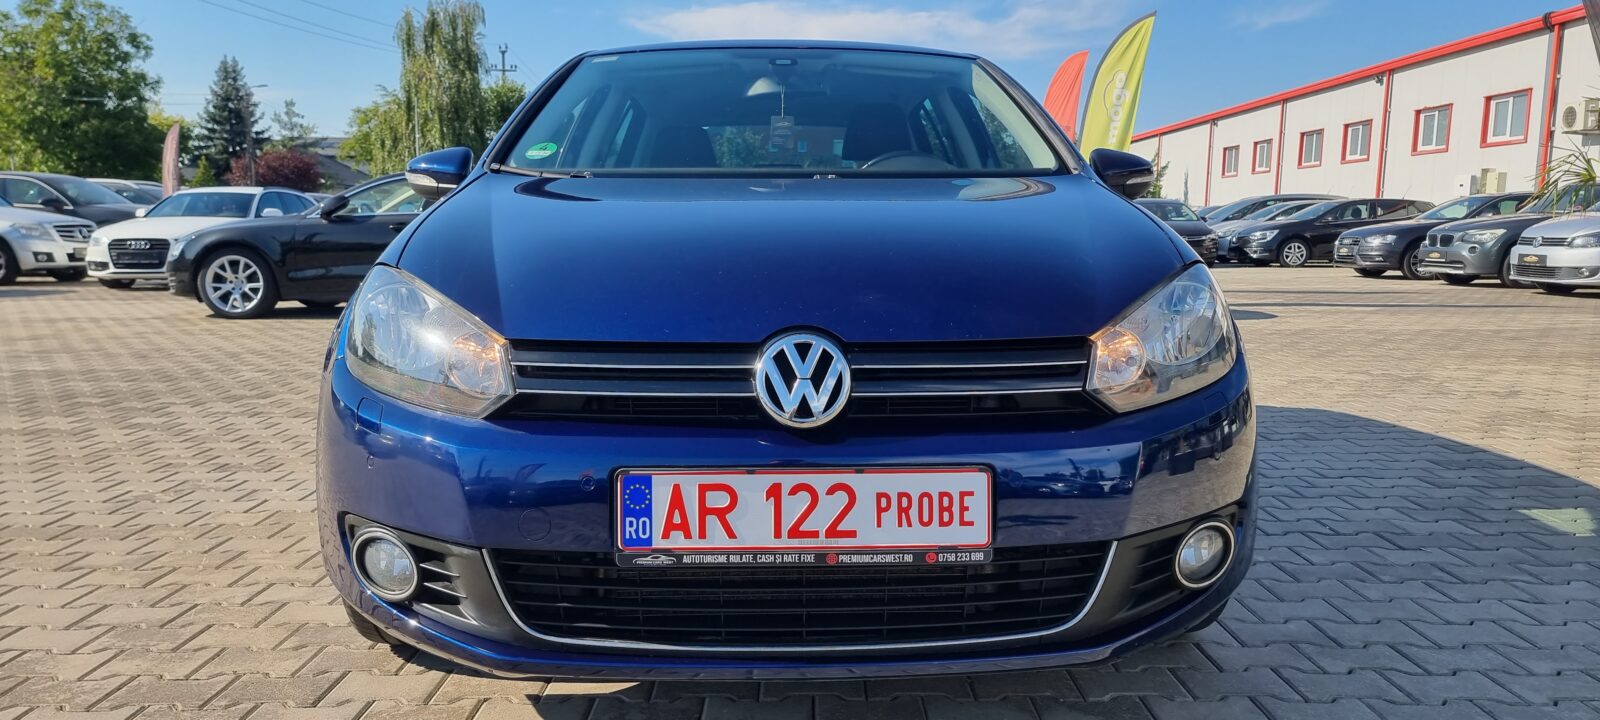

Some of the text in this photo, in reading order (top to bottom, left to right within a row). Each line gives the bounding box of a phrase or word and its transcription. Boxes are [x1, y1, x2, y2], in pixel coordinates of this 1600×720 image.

[758, 335, 849, 426] VW
[660, 482, 975, 540] AR 122 PROBE
[625, 517, 651, 540] RO
[682, 554, 728, 564] AUTOTURISME
[729, 554, 756, 564] RULATE,
[757, 554, 774, 563] CASH
[783, 554, 800, 562] RATE
[801, 554, 816, 562] FIXE
[838, 553, 913, 563] PREMIUMCARSWEST.RO
[938, 552, 984, 562] 0758 233 699
